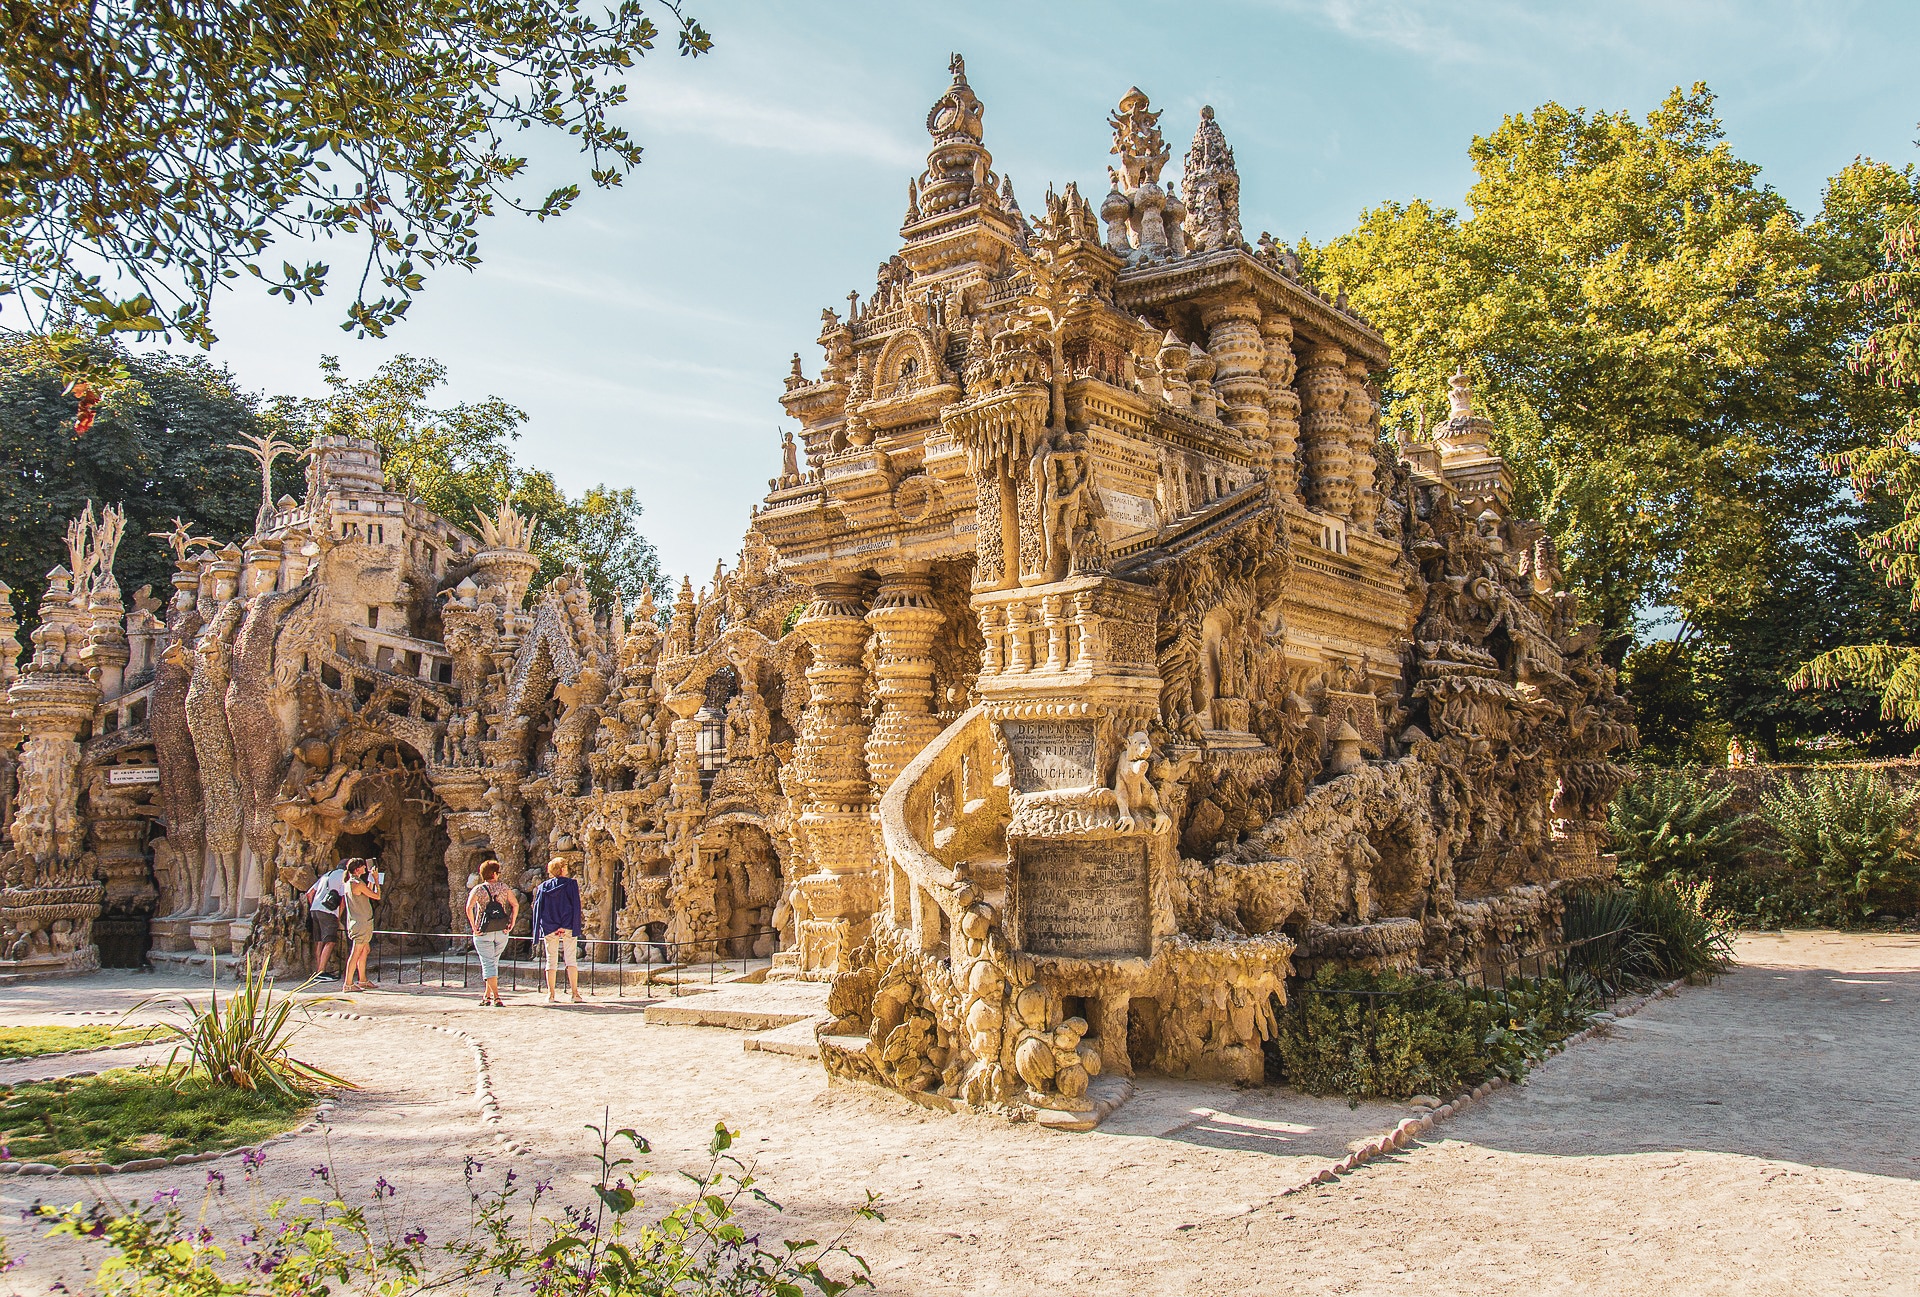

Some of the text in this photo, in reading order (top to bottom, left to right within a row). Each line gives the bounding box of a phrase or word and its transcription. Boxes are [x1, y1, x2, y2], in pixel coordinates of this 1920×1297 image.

[1023, 745, 1075, 756] DE RIEN
[1021, 768, 1083, 779] TOUCHER
